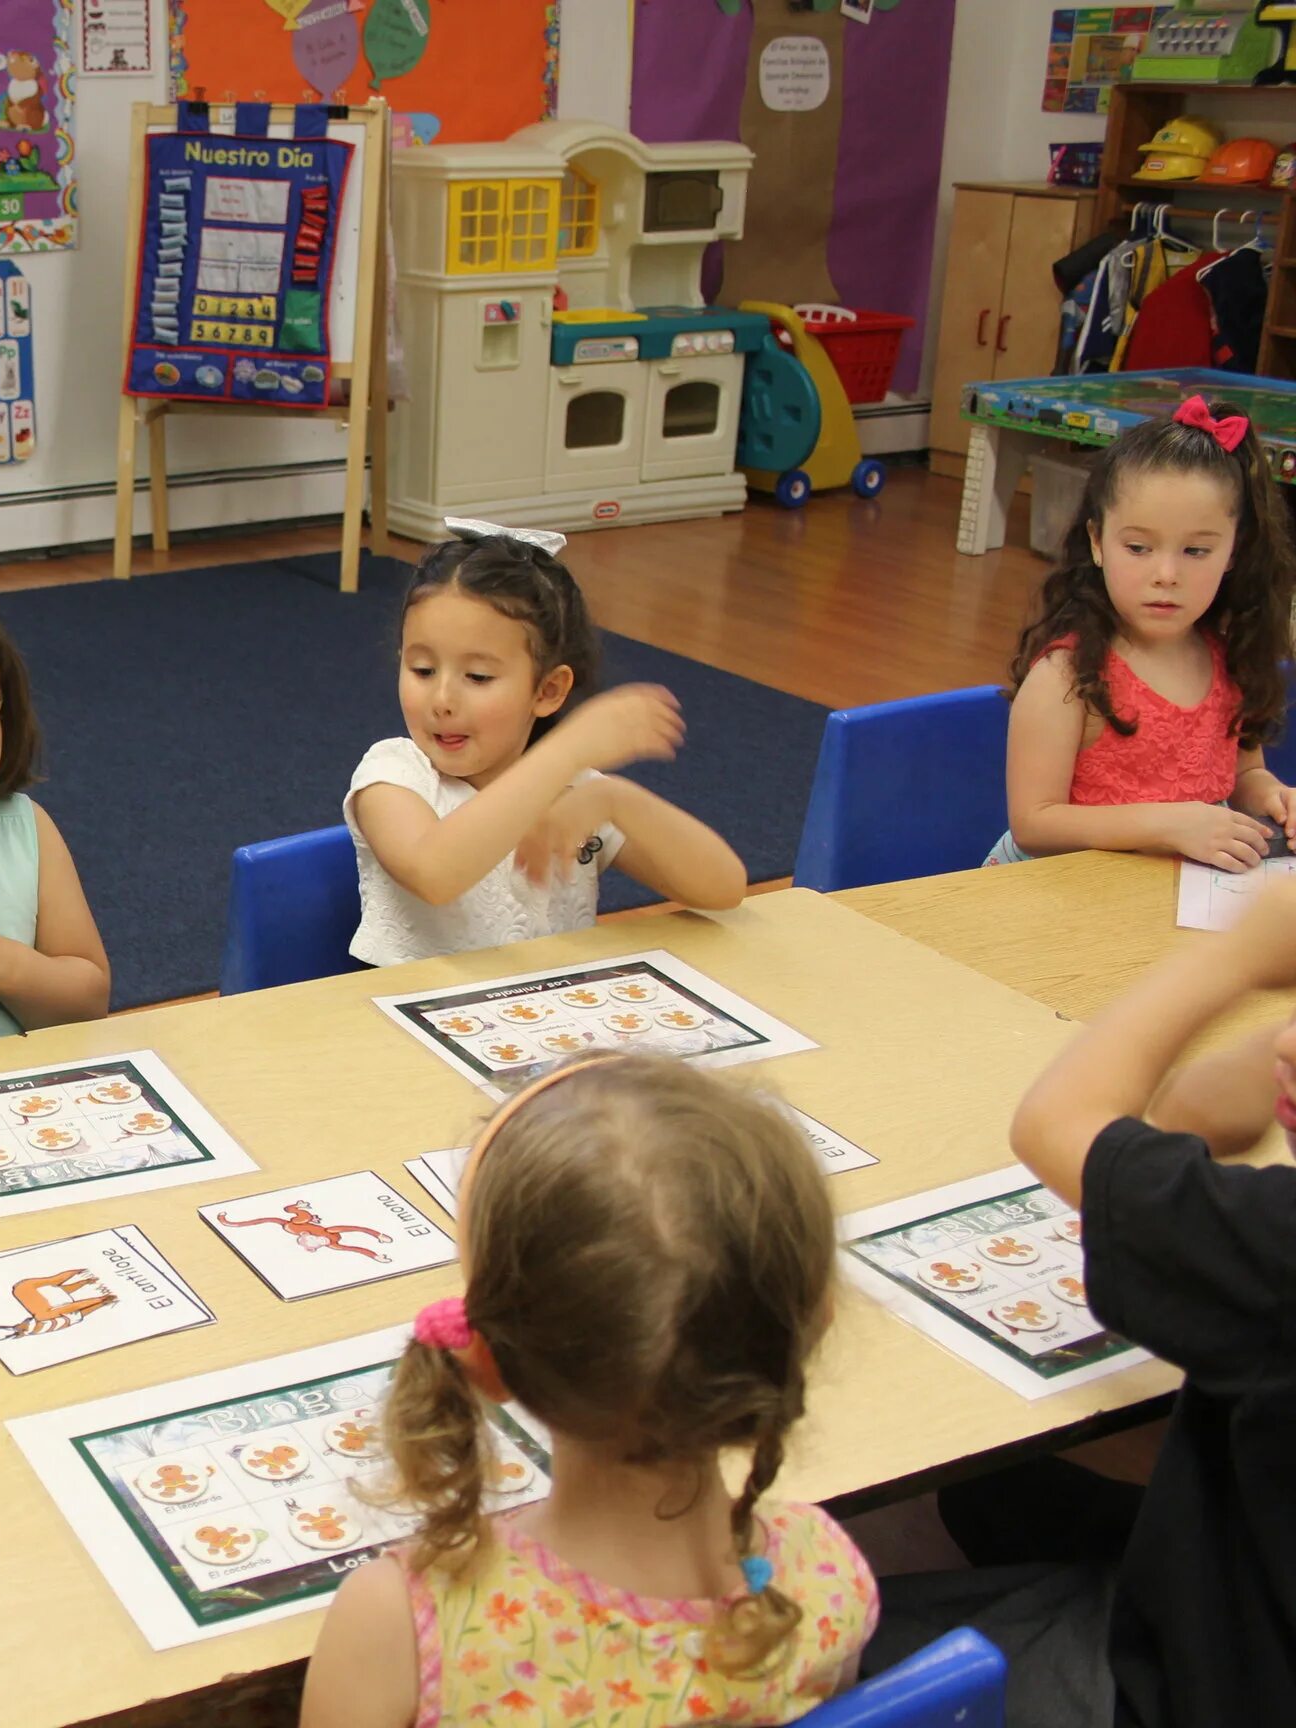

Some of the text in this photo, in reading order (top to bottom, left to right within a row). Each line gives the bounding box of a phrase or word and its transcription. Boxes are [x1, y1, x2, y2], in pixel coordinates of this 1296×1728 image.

[184, 142, 314, 168] Nuestro Día
[1, 199, 20, 215] 30
[197, 298, 207, 312] 0
[230, 303, 239, 316] 2
[246, 304, 254, 316] 3
[262, 304, 271, 317] 4
[196, 325, 268, 343] 5 6 7 8 9
[0, 345, 16, 360] Pp
[15, 405, 29, 419] Zz
[485, 979, 572, 999] Los Animales
[8, 1081, 34, 1091] Los
[818, 1146, 845, 1158] El
[377, 1195, 431, 1238] El mono
[928, 1198, 1056, 1240] Bingo
[102, 1248, 174, 1310] El antílope
[197, 1383, 363, 1436] Bingo
[328, 1553, 371, 1573] Los
